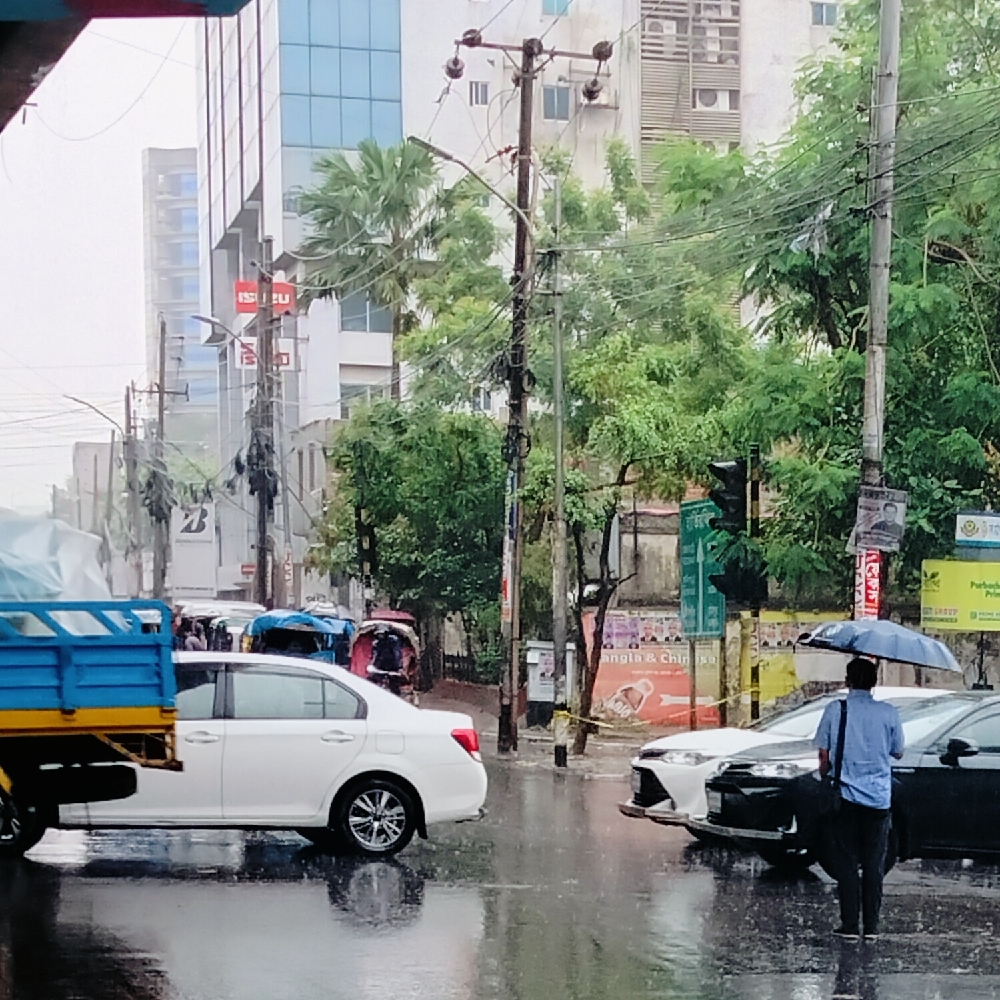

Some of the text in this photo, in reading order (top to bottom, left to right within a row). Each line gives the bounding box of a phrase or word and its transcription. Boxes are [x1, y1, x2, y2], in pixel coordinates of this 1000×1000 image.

[600, 652, 718, 664] angla & Chinse
